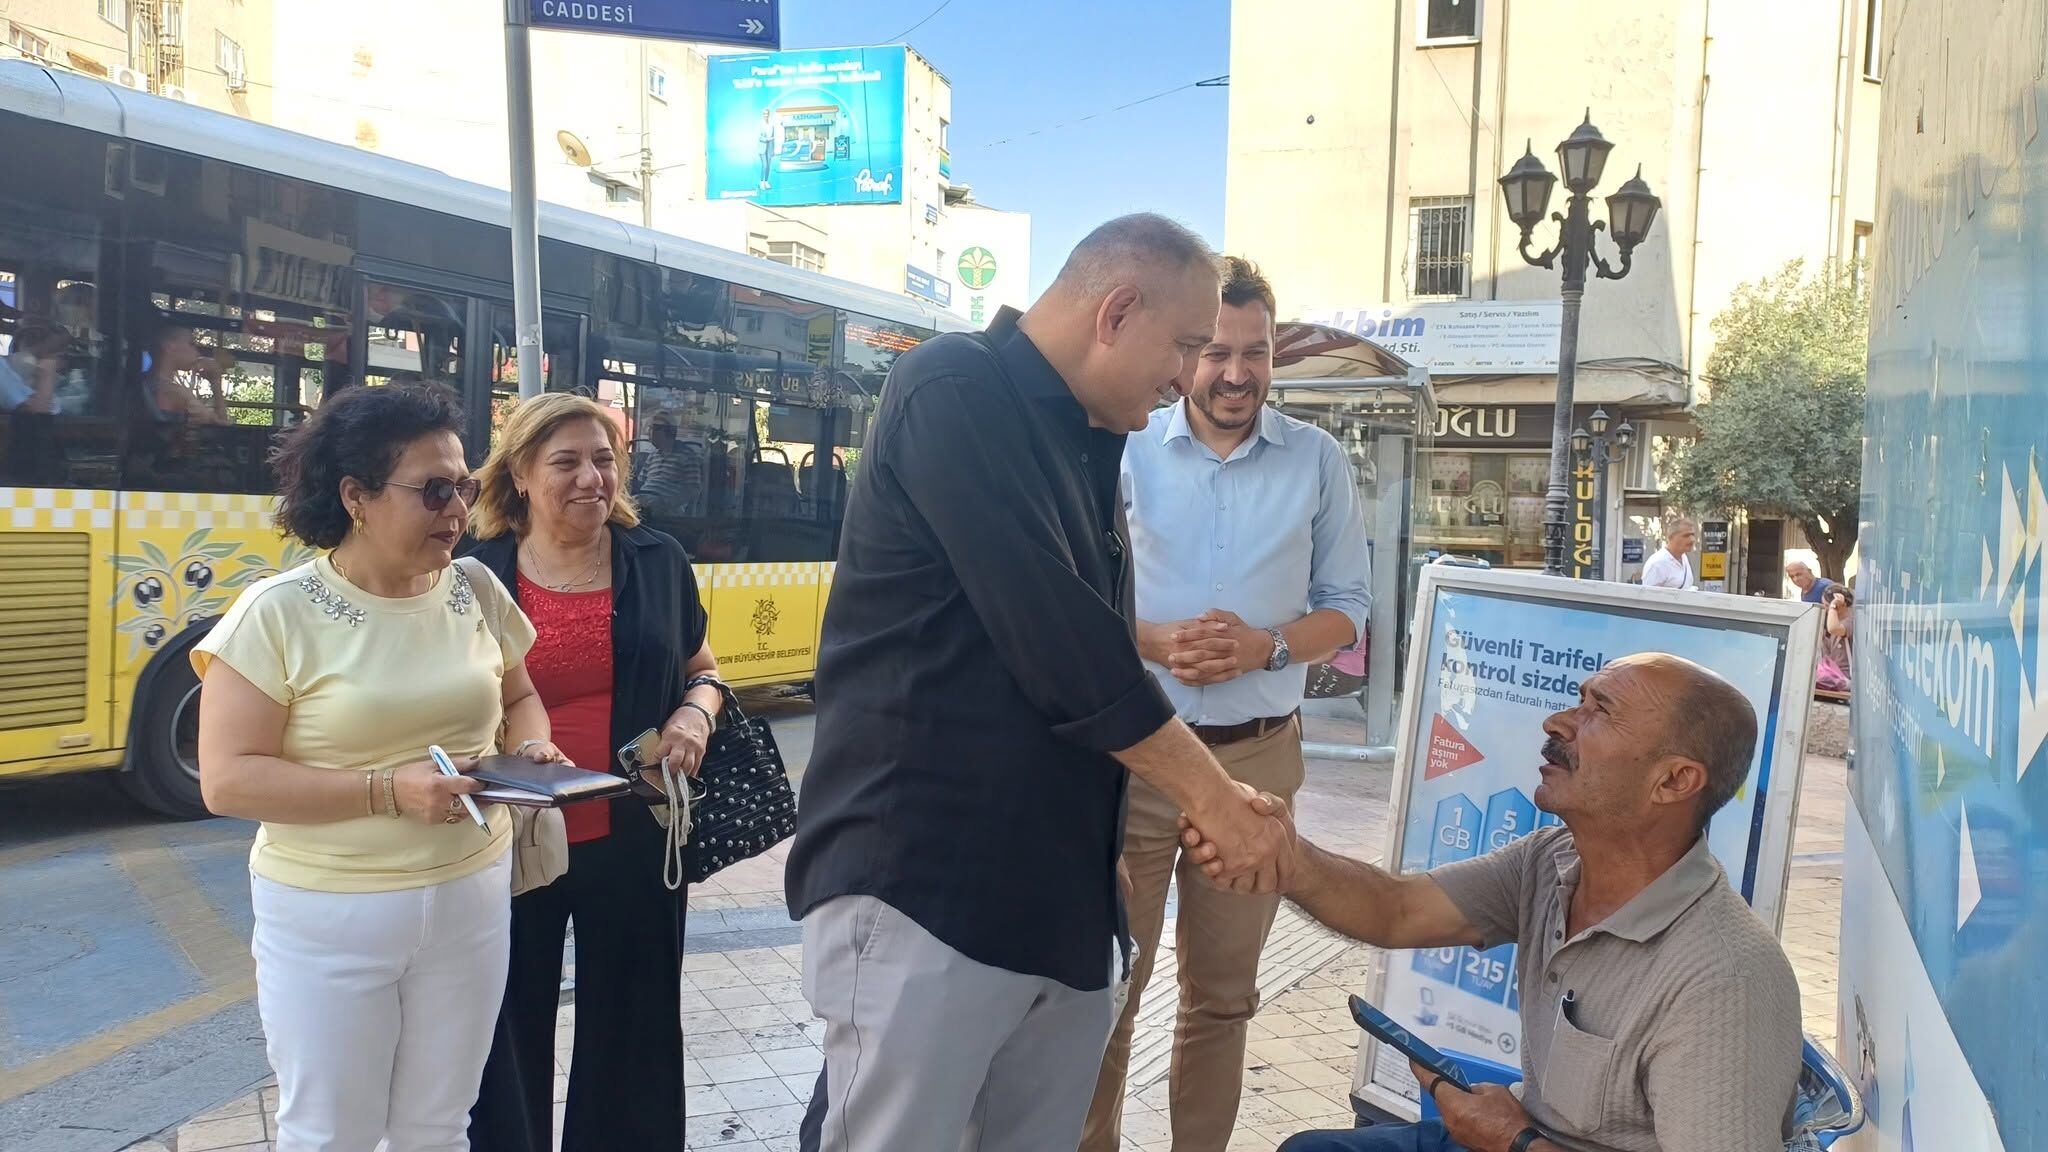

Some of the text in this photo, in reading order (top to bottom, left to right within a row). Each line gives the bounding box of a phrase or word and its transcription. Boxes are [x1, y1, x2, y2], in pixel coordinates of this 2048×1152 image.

[543, 1, 633, 23] CADDESİ
[1483, 310, 1507, 318] Servis
[1384, 342, 1421, 355] td.Şti.
[1417, 404, 1517, 437] OĞLU
[734, 650, 776, 662] BÜYÜKŞEHİR
[776, 646, 811, 659] BELEDİYESİ
[1446, 629, 1524, 660] Güvenli
[1441, 653, 1579, 696] kontrol sizde
[1900, 570, 1995, 759] Telekom
[1505, 690, 1543, 708] faturalı
[1433, 735, 1465, 751] Fatura
[1430, 758, 1449, 769] yok
[1431, 748, 1458, 760] aşımı
[1453, 807, 1463, 826] 1
[1502, 809, 1517, 831] 5
[1440, 825, 1471, 850] GB
[1465, 951, 1505, 984] 215
